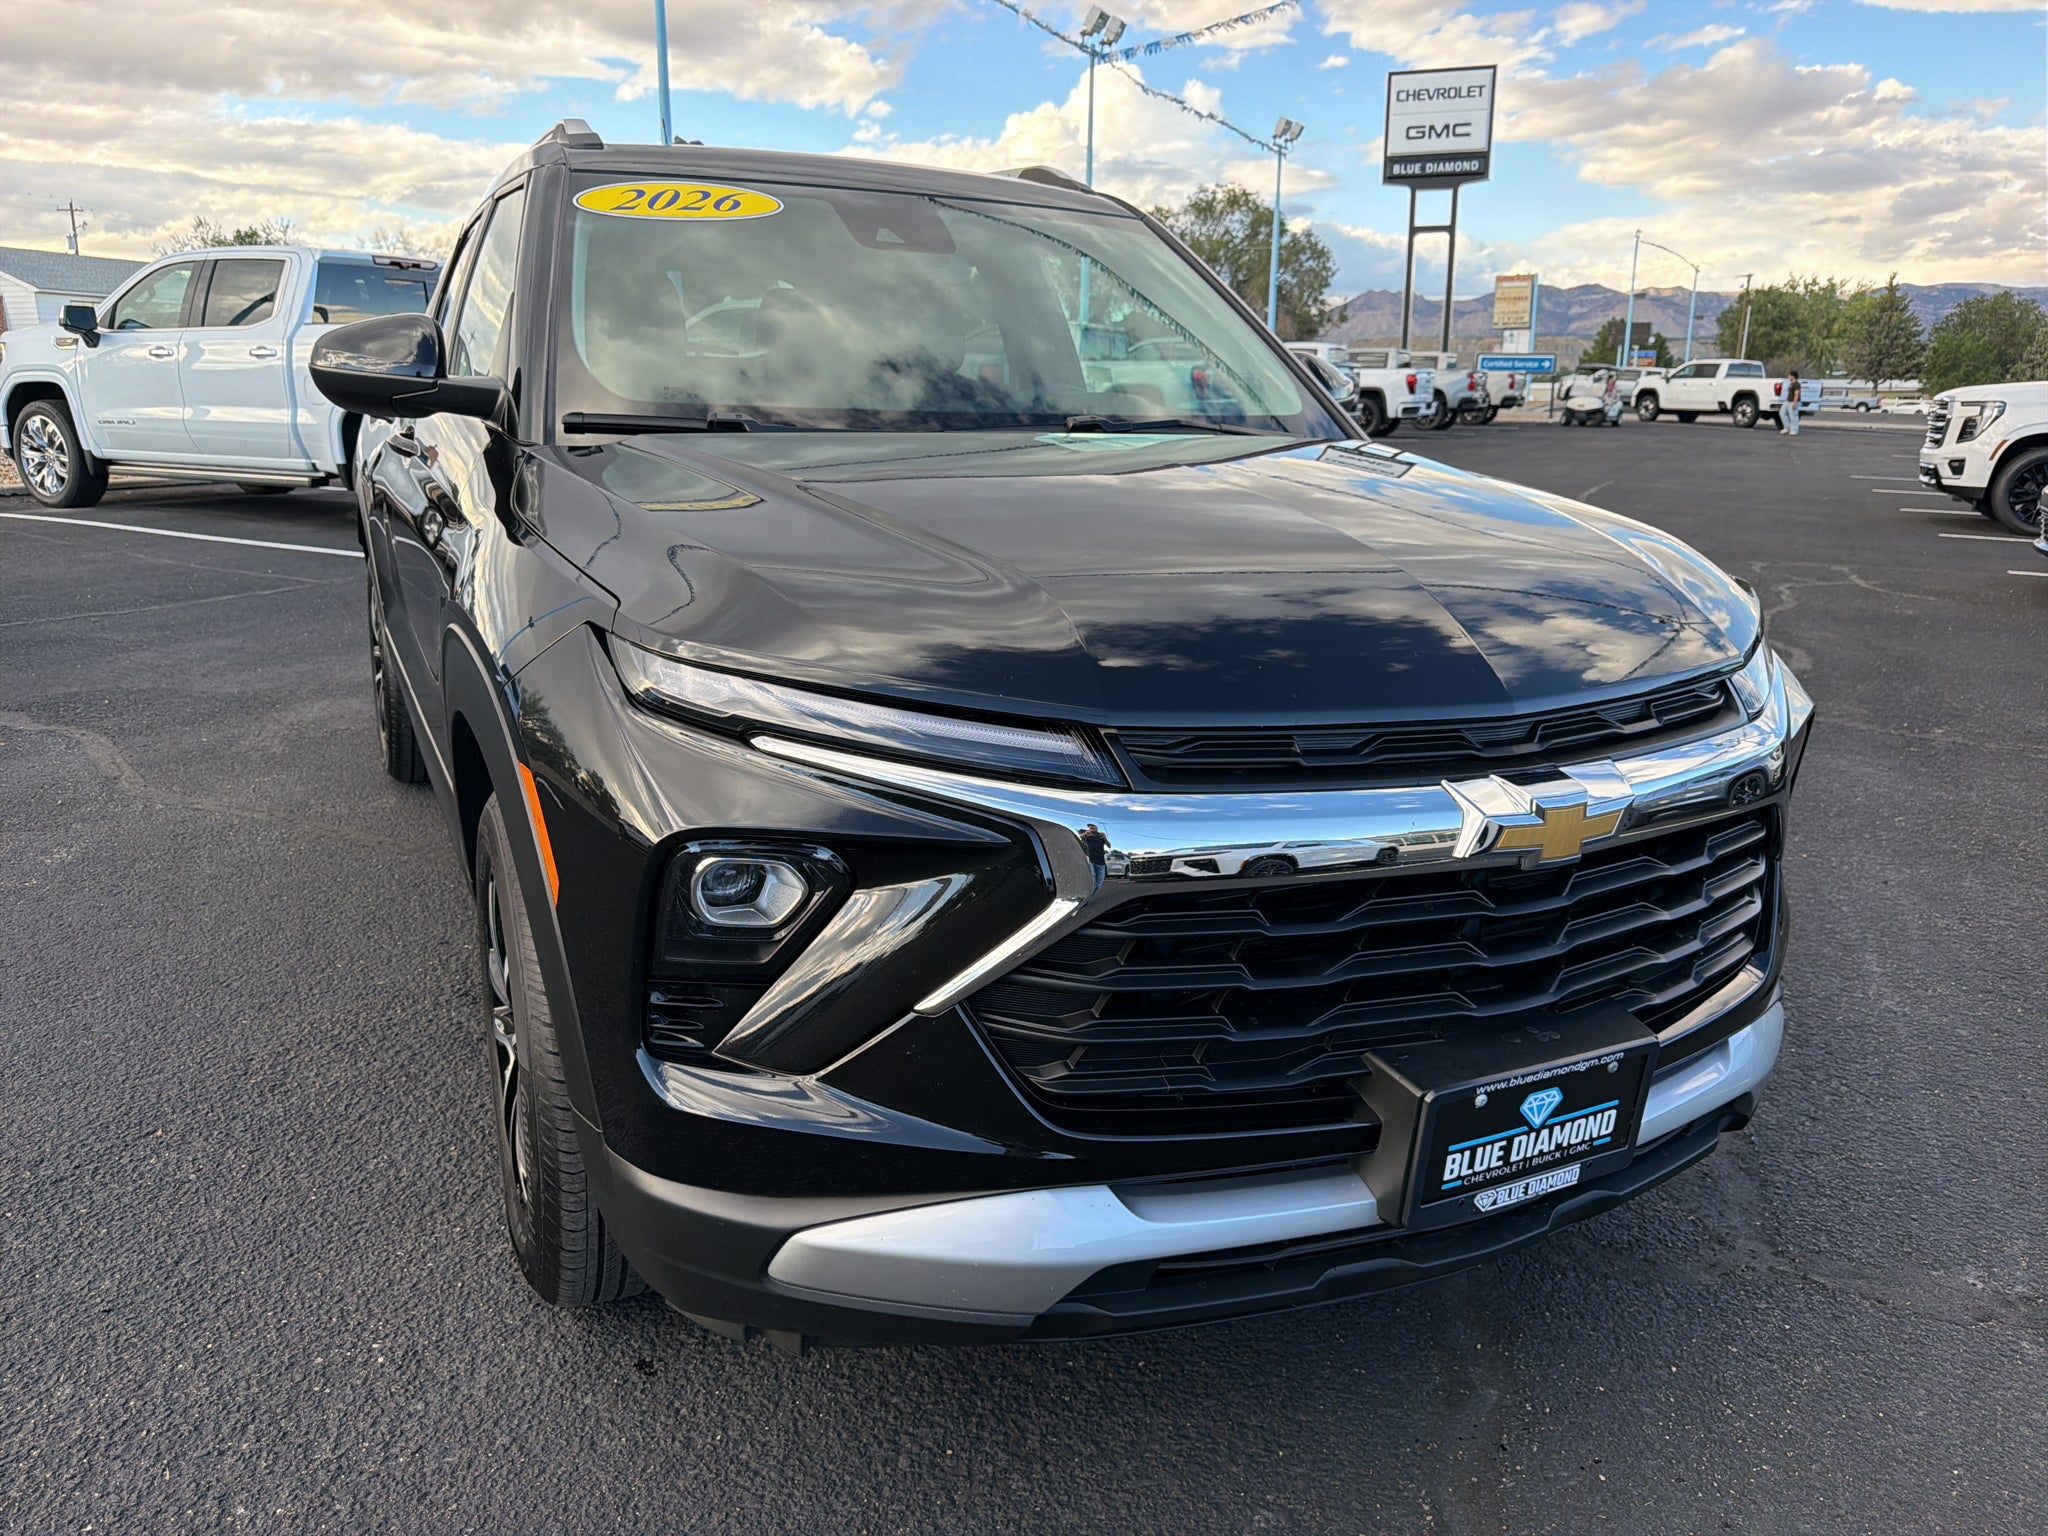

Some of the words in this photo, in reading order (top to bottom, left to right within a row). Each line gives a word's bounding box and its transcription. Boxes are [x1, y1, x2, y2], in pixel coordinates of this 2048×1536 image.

[1396, 85, 1486, 102] CHEVROLET
[1406, 122, 1472, 140] GMC
[1392, 162, 1422, 175] BLUE
[1425, 160, 1479, 174] DIAMOND
[609, 188, 748, 212] 2026
[1482, 360, 1513, 369] Certified
[1514, 360, 1539, 369] Service
[1476, 1051, 1624, 1095] www.bluediamondgm.com
[1442, 1140, 1508, 1182] BLUE
[1509, 1109, 1618, 1163] DIAMOND
[1463, 1163, 1524, 1186] CHEVROLET
[1531, 1150, 1562, 1168] BUICK
[1569, 1141, 1592, 1155] GMC
[1496, 1183, 1528, 1205] BLUE
[1527, 1167, 1580, 1195] DIAMOND
